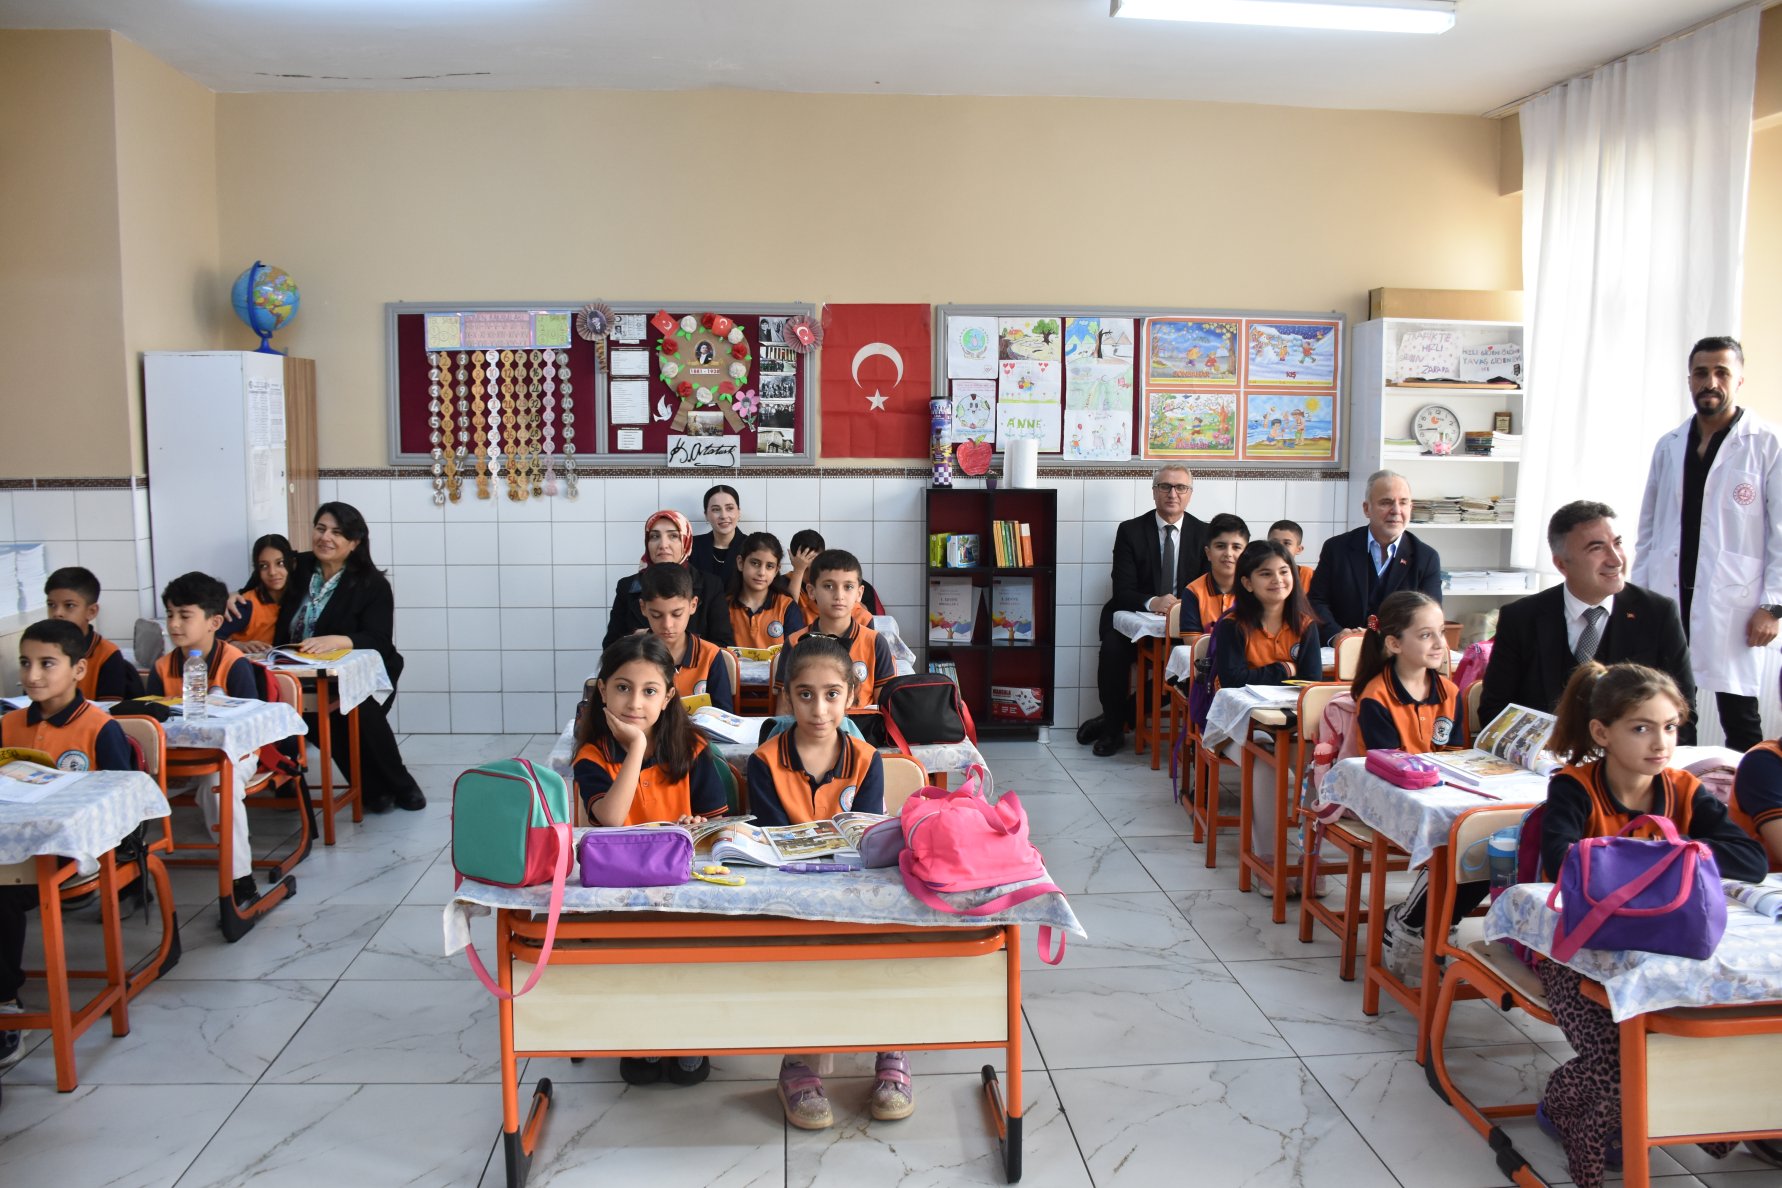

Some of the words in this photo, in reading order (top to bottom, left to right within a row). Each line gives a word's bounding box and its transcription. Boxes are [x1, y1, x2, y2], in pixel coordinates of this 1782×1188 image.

[430, 354, 437, 366] 1
[442, 356, 449, 366] 2
[460, 354, 467, 365] 3
[474, 352, 482, 363] 4
[488, 351, 497, 360] 5
[503, 352, 511, 363] 6
[518, 352, 524, 363] 7
[533, 352, 539, 362] 8
[546, 352, 553, 362] 9
[431, 369, 441, 381] 2
[442, 372, 449, 382] 4
[459, 369, 465, 380] 6
[476, 369, 482, 380] 8
[503, 367, 513, 379] 12
[532, 367, 541, 378] 16
[559, 369, 571, 380] 20
[431, 385, 439, 397] 3
[444, 387, 450, 398] 6
[459, 385, 466, 397] 9
[503, 384, 513, 394] 18
[531, 383, 541, 394] 24
[431, 399, 439, 412] 4
[444, 403, 450, 413] 8
[459, 400, 468, 411] 12
[530, 399, 540, 409] 32
[431, 416, 439, 428] 5
[459, 415, 468, 427] 15
[504, 415, 515, 425] 30
[529, 414, 541, 423] 40
[562, 413, 574, 424] 50
[1007, 417, 1041, 429] ANNE
[432, 431, 439, 443] 6
[459, 431, 469, 442] 18
[505, 430, 515, 441] 36
[530, 429, 540, 440] 48
[434, 447, 442, 460] 7
[456, 446, 466, 457] 21
[530, 443, 541, 454] 56
[434, 463, 442, 474] 8
[565, 459, 576, 470] 80
[531, 473, 542, 483] 72
[435, 479, 443, 490] 9
[434, 491, 445, 504] 10
[533, 487, 543, 497] 80
